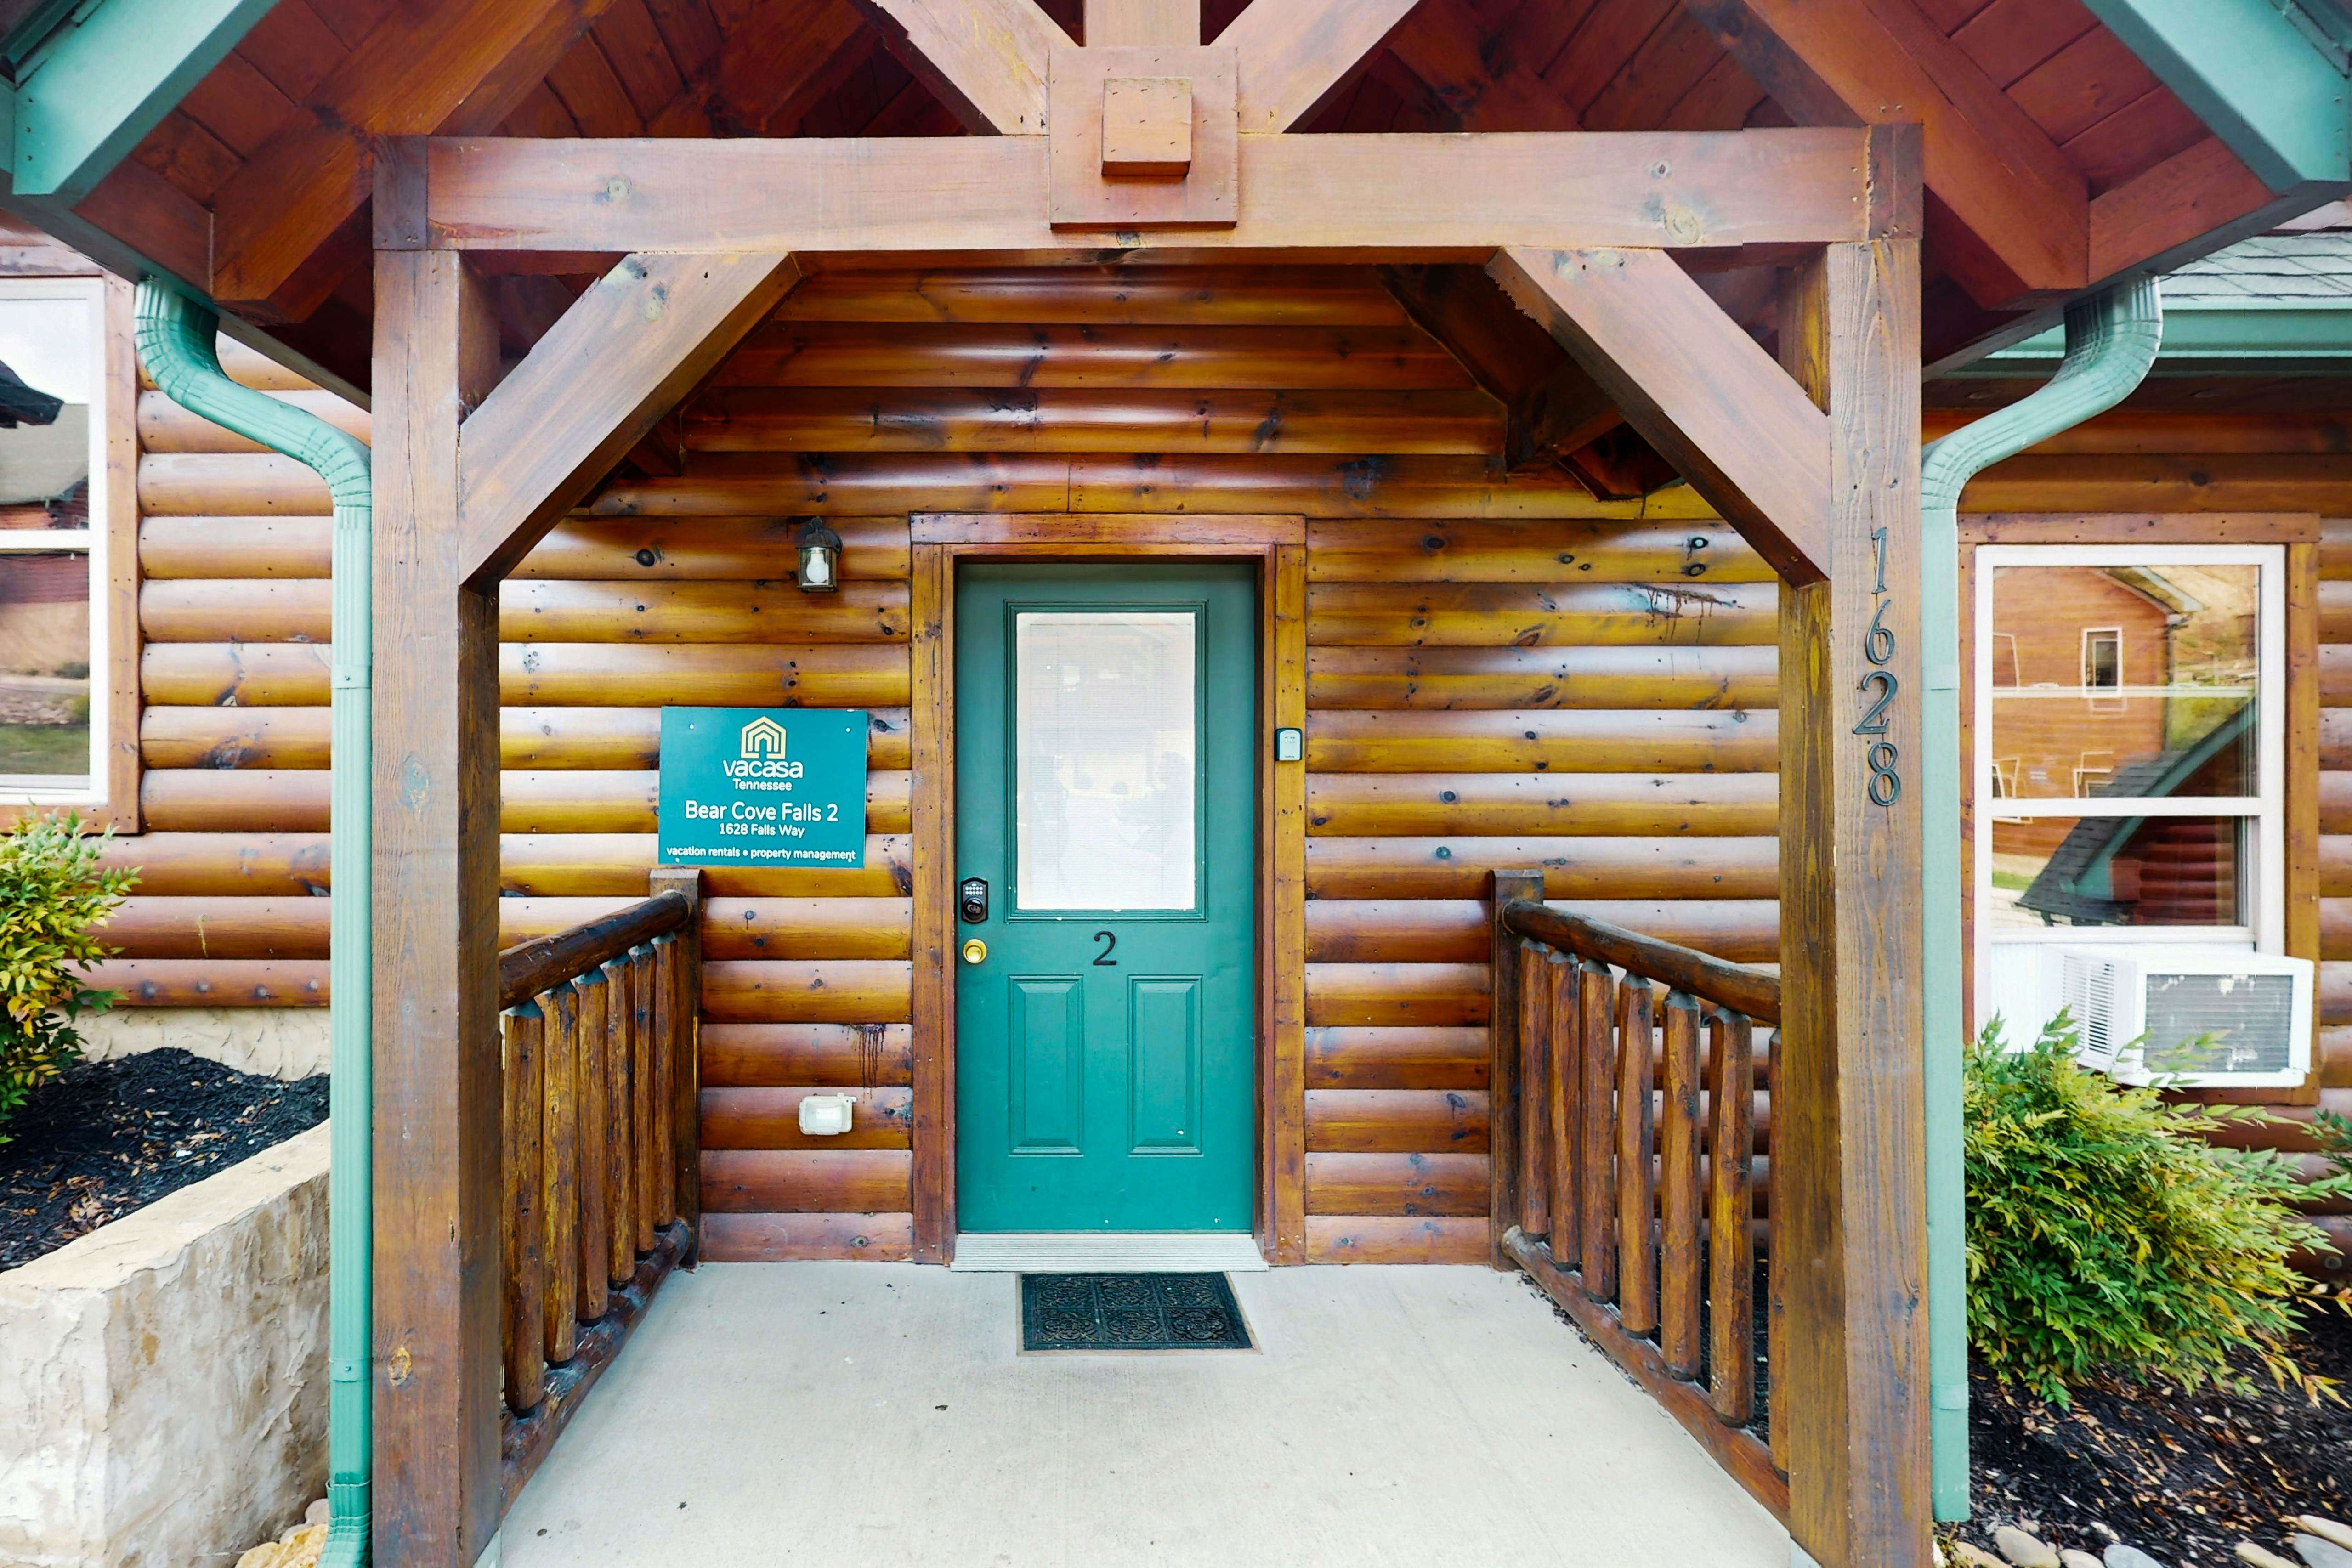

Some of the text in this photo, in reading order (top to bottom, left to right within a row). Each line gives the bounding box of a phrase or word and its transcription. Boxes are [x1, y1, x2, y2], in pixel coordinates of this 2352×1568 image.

[1852, 526, 1901, 806] 1628
[723, 759, 804, 778] vacasa
[733, 778, 792, 791] Tennessee
[685, 800, 839, 822] Bear Cove Falls 2
[719, 823, 805, 838] 1628 Falls Way
[666, 846, 856, 862] vacation rentals property management
[1093, 930, 1117, 966] 2
